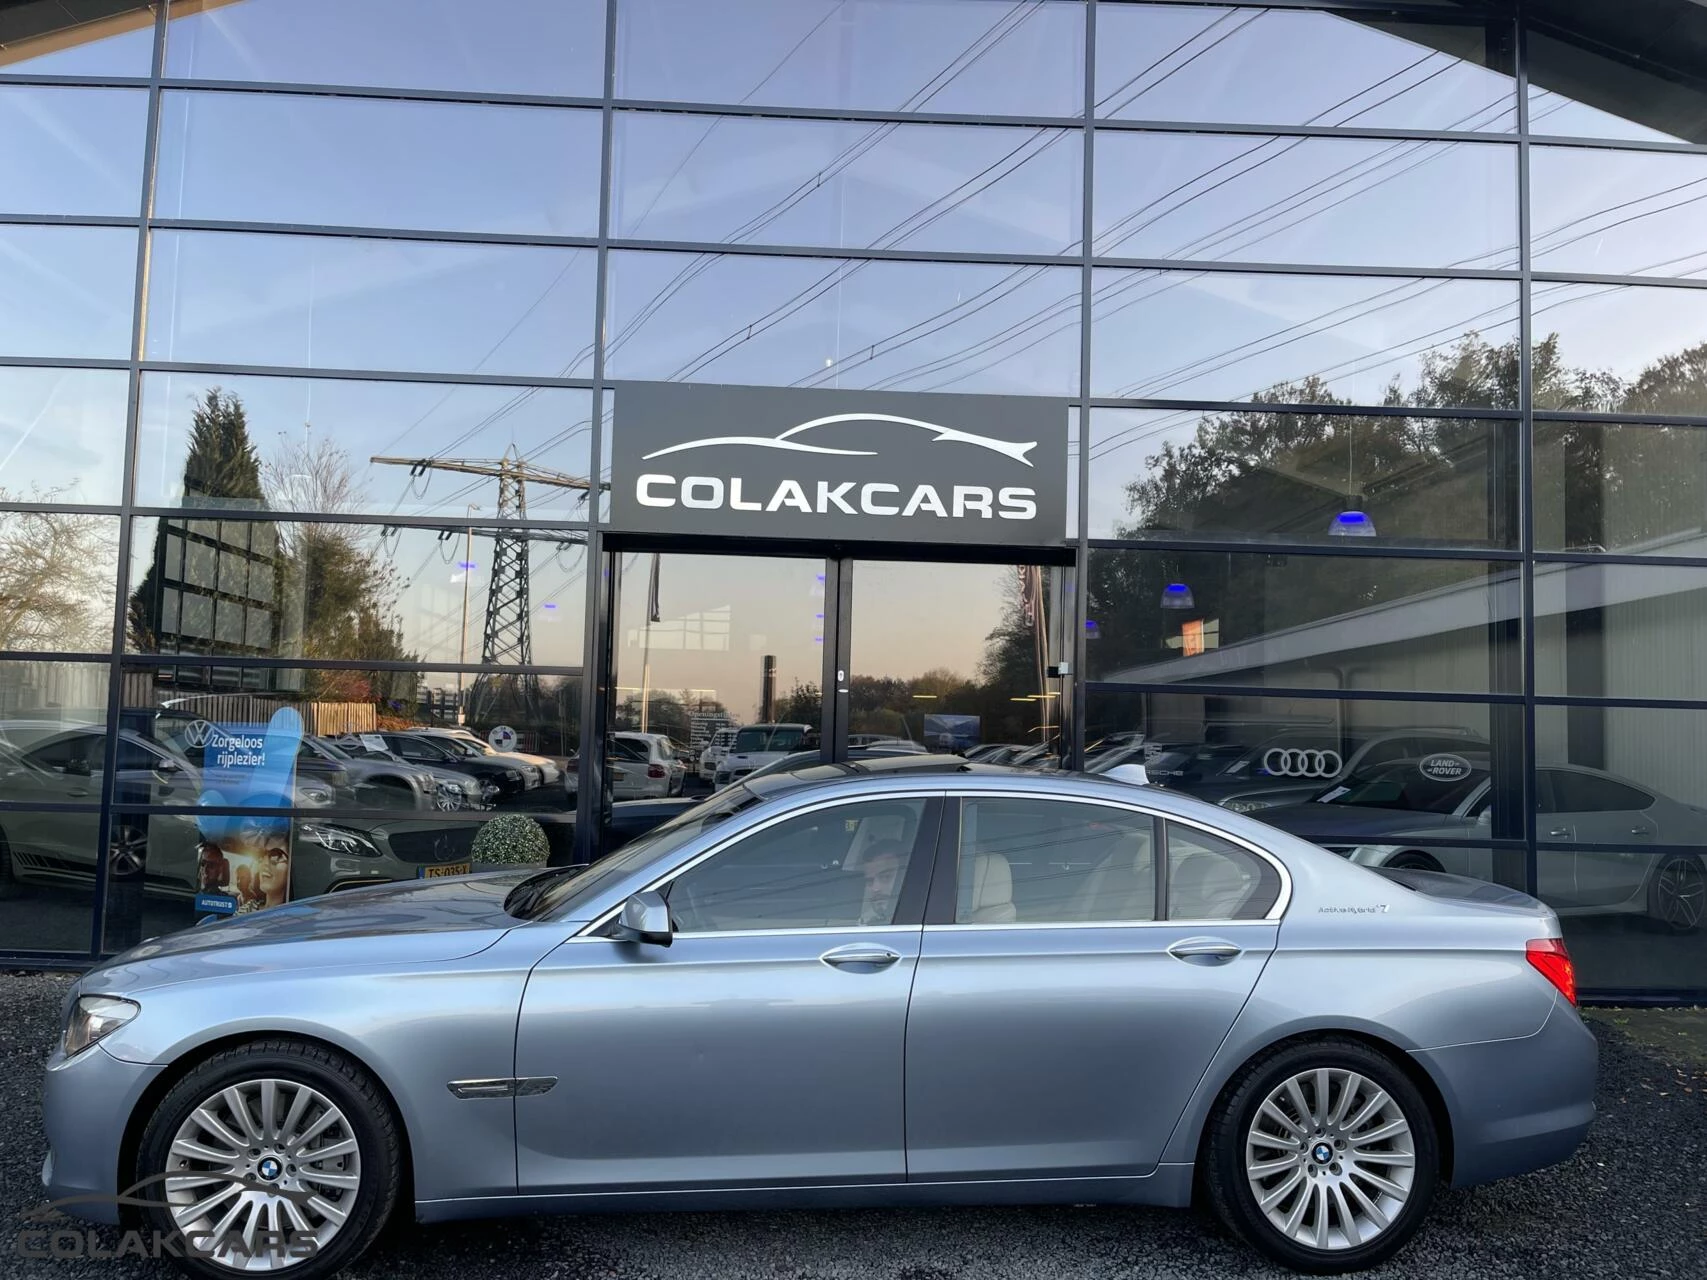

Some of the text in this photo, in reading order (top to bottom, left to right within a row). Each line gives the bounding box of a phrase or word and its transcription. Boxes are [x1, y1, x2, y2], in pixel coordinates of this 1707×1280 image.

[636, 474, 1037, 520] COLAKCARS
[212, 734, 263, 753] Zorgeloos
[217, 751, 265, 768] rijplezier!
